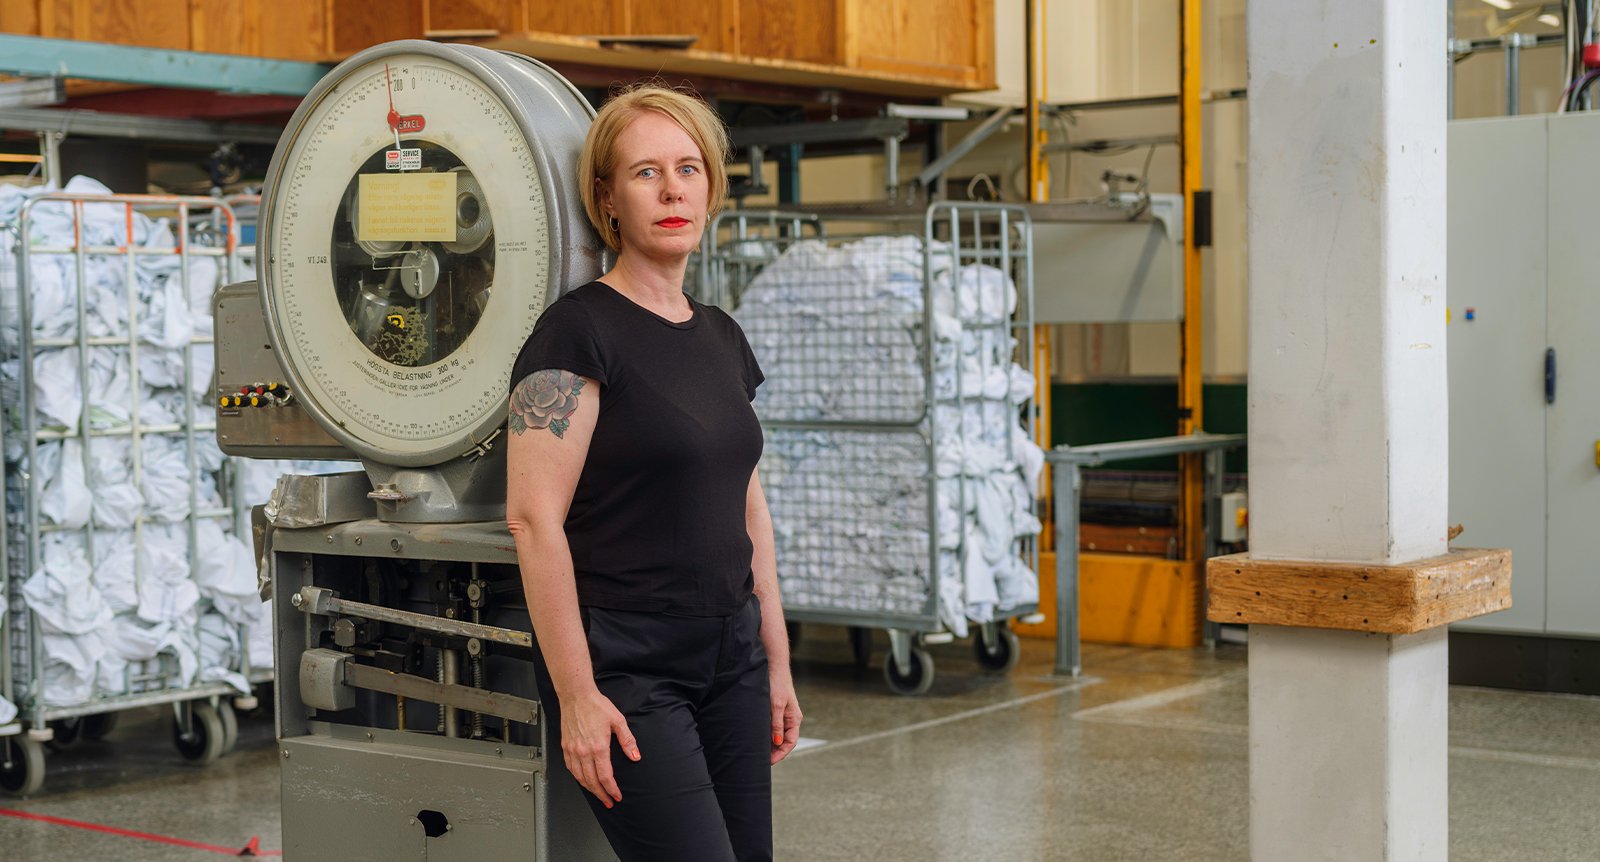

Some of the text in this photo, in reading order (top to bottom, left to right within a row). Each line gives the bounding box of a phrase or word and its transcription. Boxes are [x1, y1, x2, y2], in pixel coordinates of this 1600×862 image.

[393, 78, 403, 92] 200
[411, 76, 416, 90] 0
[399, 119, 421, 129] ERKEL
[392, 370, 432, 381] BELASTNING
[437, 363, 449, 375] 300
[450, 358, 459, 367] kg
